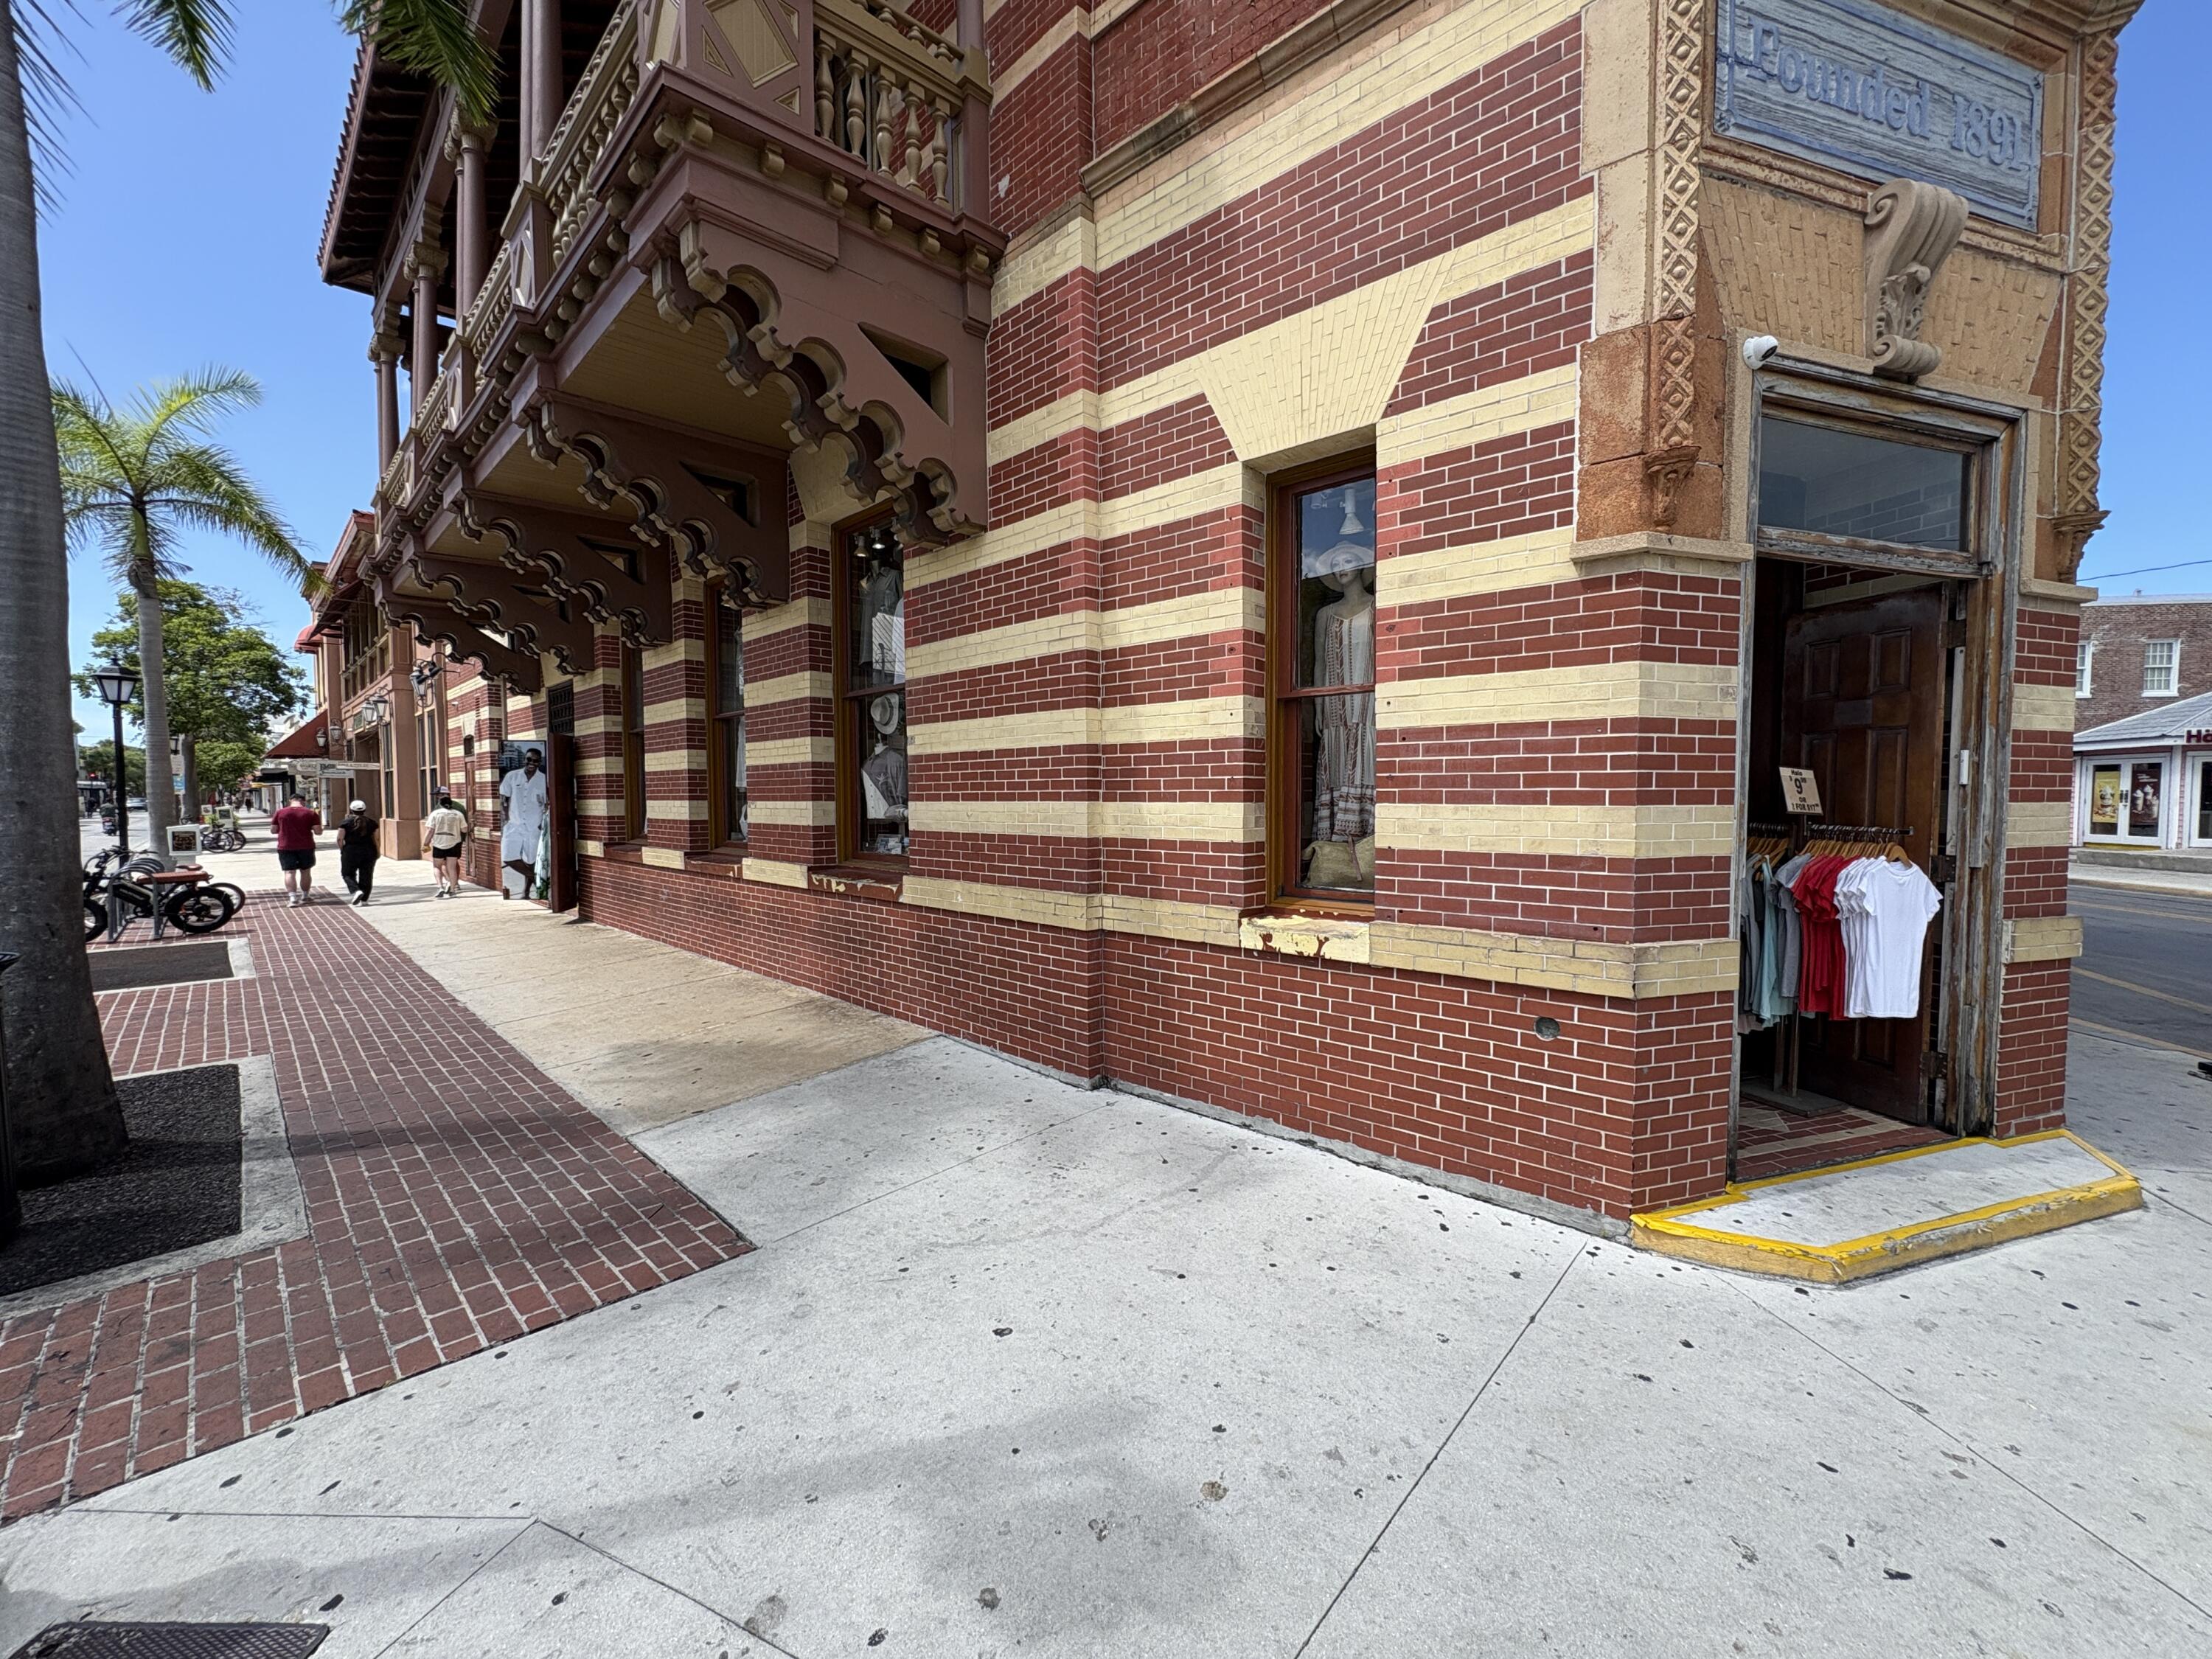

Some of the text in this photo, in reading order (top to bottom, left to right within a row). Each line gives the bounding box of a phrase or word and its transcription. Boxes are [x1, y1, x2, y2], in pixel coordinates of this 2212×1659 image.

[1747, 18, 2031, 170] Founded 1891
[1795, 803, 1806, 811] FOR
